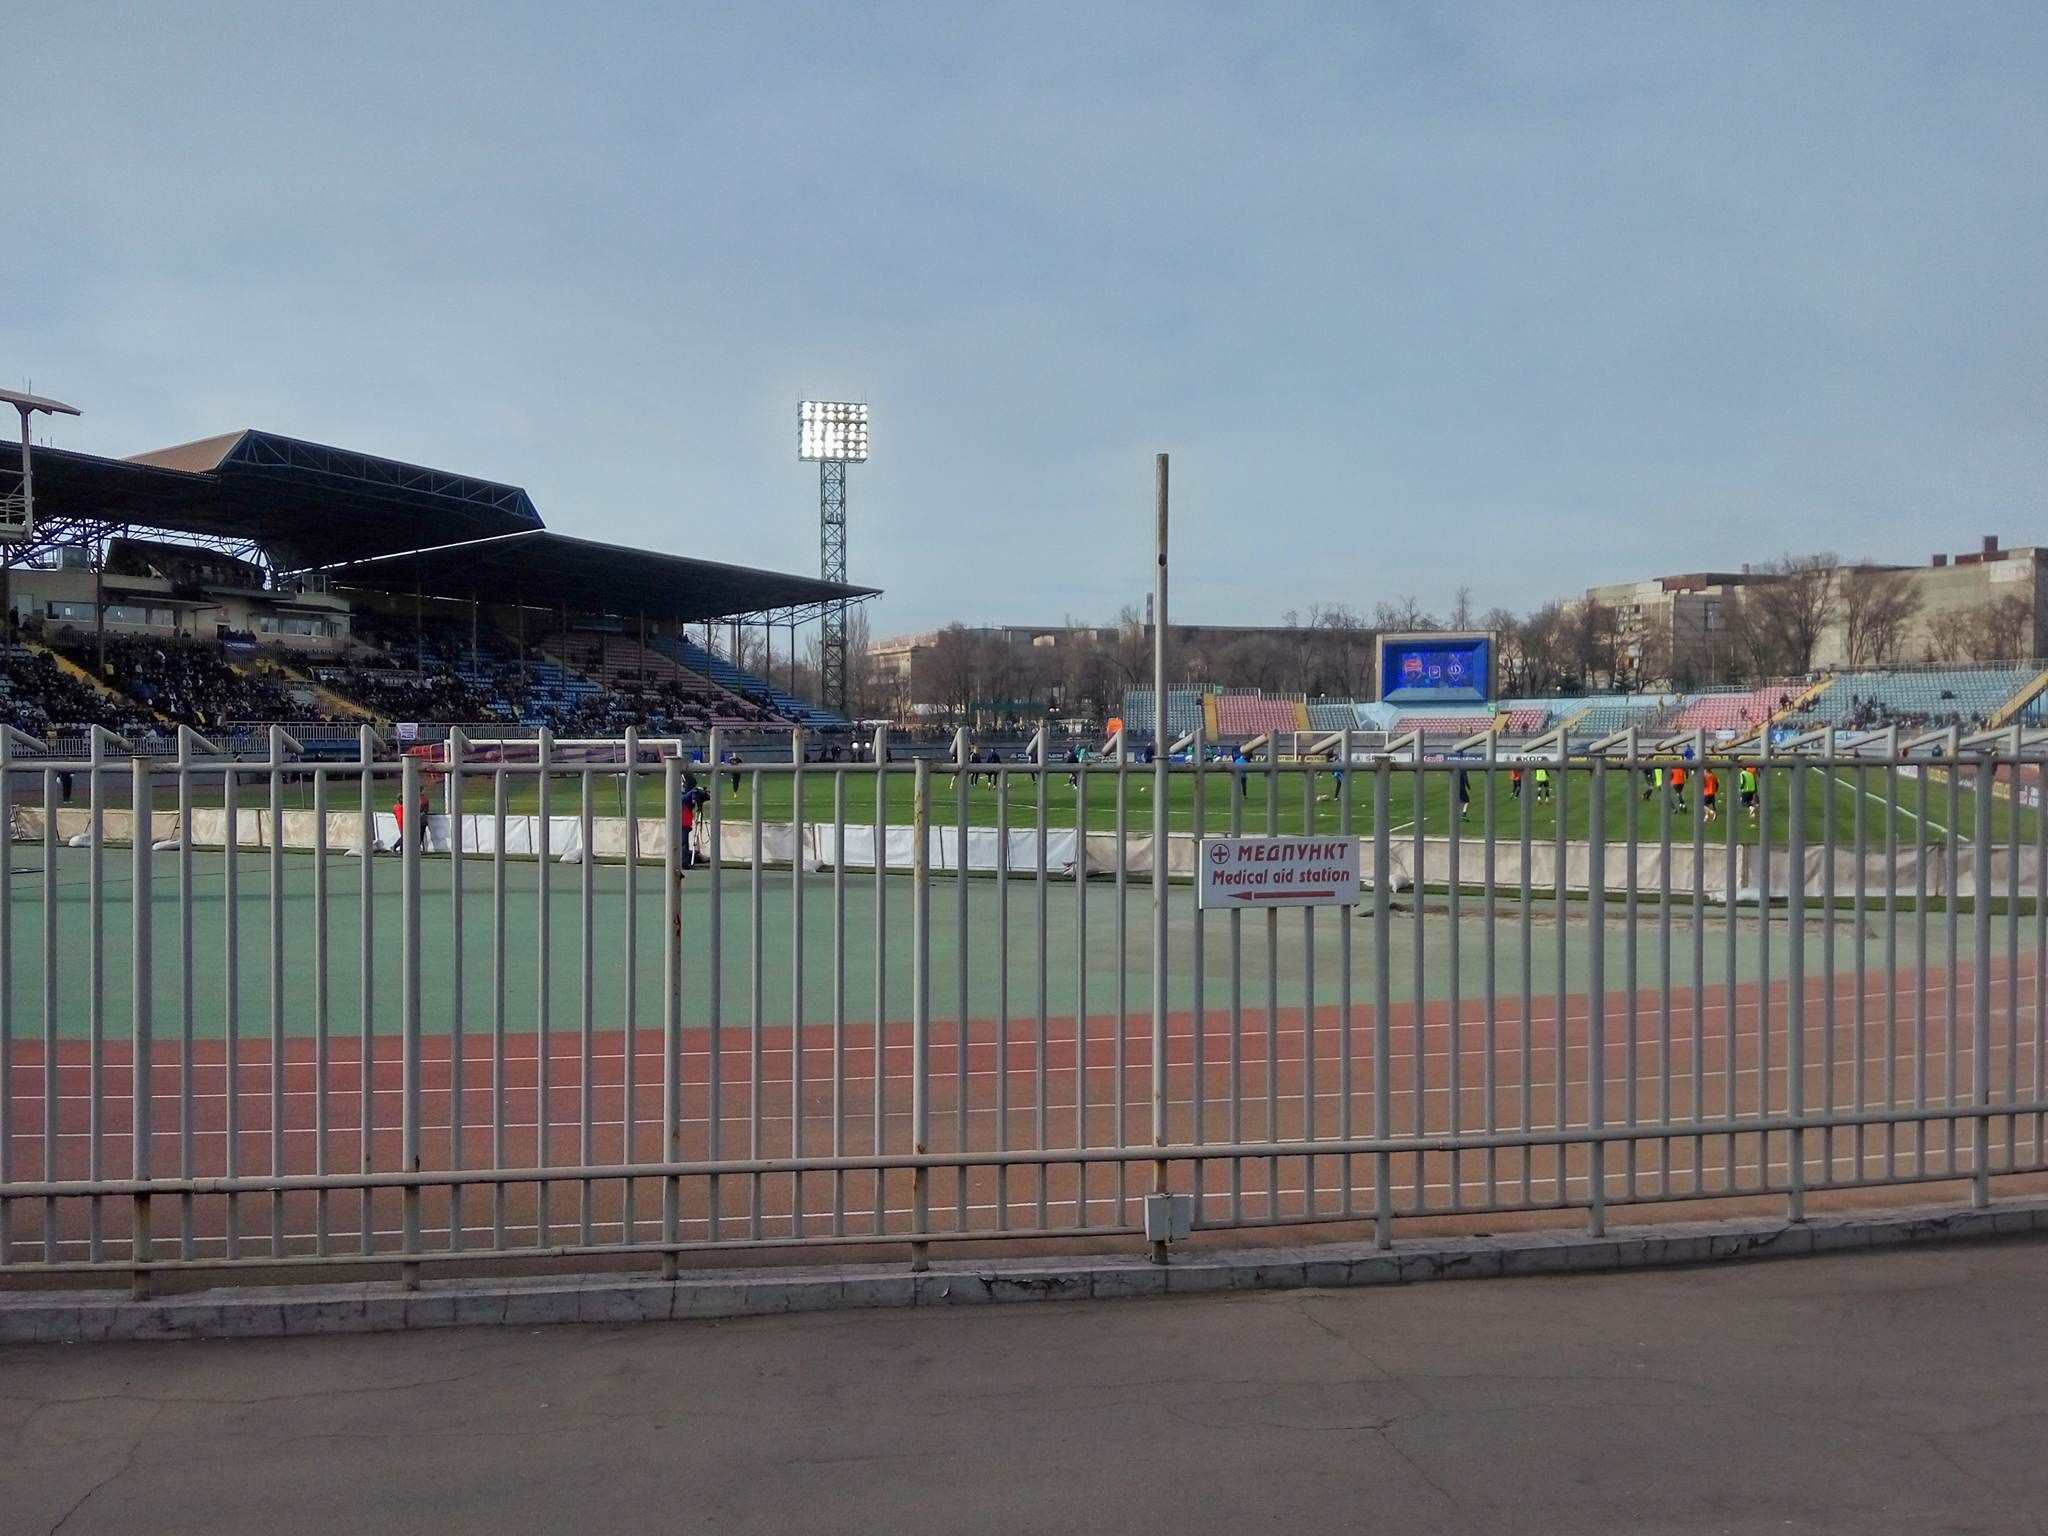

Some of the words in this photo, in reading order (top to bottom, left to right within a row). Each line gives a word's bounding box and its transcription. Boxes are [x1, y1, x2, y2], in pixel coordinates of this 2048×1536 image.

[1237, 843, 1348, 862] МЕДПУНКТ
[1212, 869, 1267, 885] Medical
[1273, 868, 1294, 883] aid
[1299, 867, 1350, 882] station
